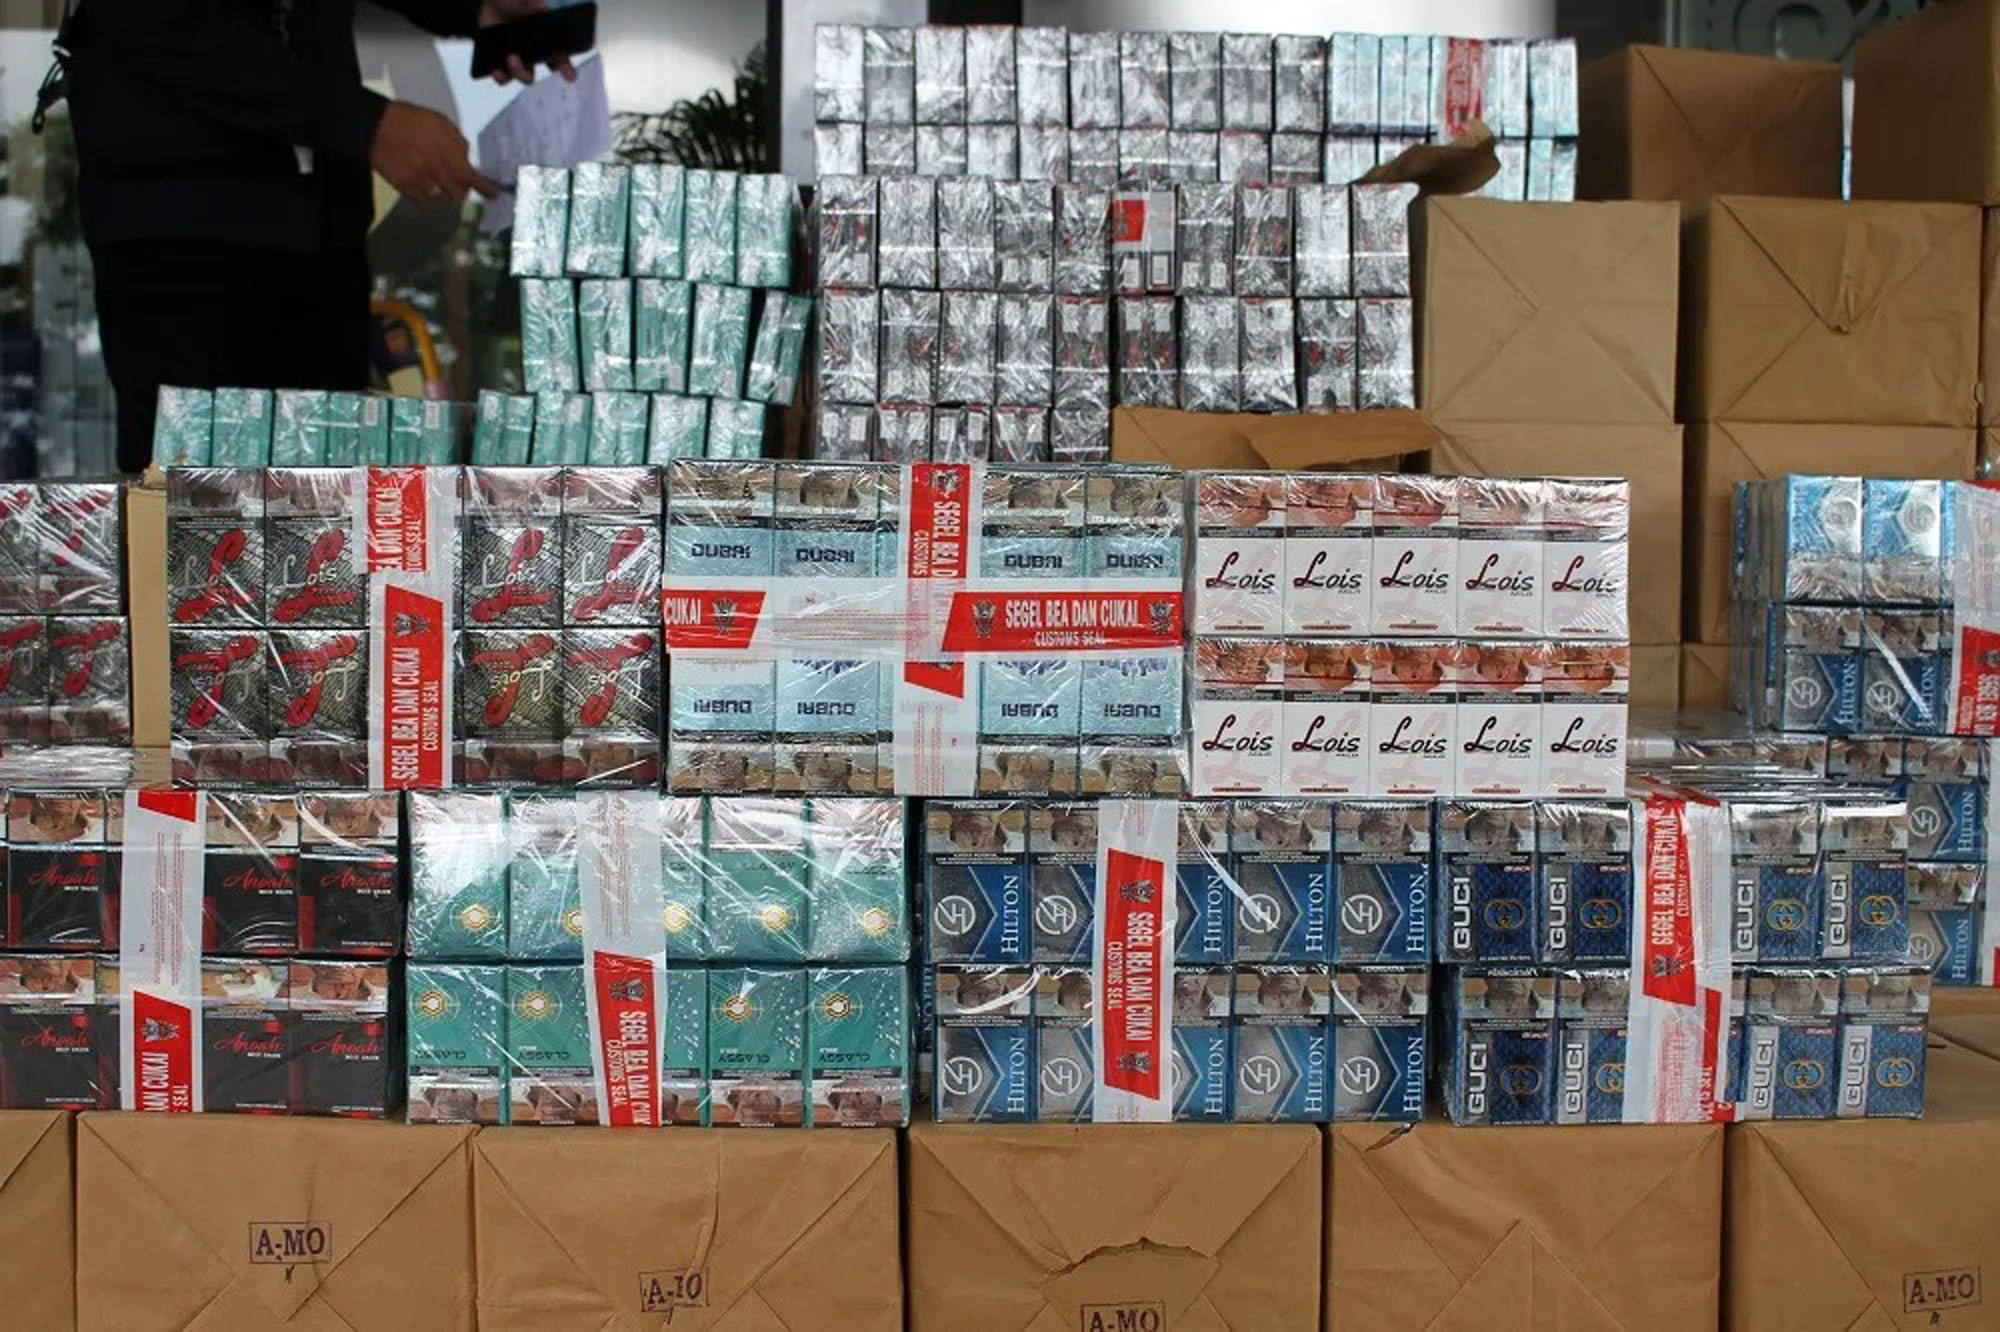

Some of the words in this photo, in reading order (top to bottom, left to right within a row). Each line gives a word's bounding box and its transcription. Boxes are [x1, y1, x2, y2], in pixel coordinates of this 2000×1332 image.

[933, 501, 961, 539] SEGEL
[376, 528, 402, 554] DAN
[691, 543, 750, 559] DUBAI
[796, 548, 854, 563] DUBAI
[914, 530, 929, 575] CUSTOMS
[932, 542, 960, 566] BEA
[279, 554, 337, 589] Lois
[1004, 553, 1062, 569] DUBAI
[1206, 551, 1275, 590] Lois
[1293, 550, 1362, 589] Lois
[1380, 550, 1449, 589] Lois
[1465, 553, 1534, 592] Lois
[664, 597, 701, 625] CUKAI
[1005, 600, 1043, 628] SEGEL
[1047, 600, 1070, 628] BEA
[1072, 600, 1097, 627] DAN
[1101, 600, 1139, 627] CUKAI
[1035, 631, 1079, 647] CUSTOMS
[391, 647, 420, 686] CUKAI
[490, 660, 552, 700] Lois
[391, 688, 419, 714] DAN
[422, 680, 439, 704] SEAL
[694, 699, 752, 714] DUBAI
[798, 701, 855, 716] DUBAI
[1002, 703, 1059, 718] DUBAI
[1104, 703, 1161, 718] DUBAI
[1836, 661, 1857, 724] HILTON
[391, 717, 419, 741] BEA
[422, 707, 439, 752] CUSTOMS
[1202, 714, 1274, 752] Lois
[1291, 715, 1361, 753] Lois
[1379, 715, 1447, 753] Lois
[1463, 715, 1533, 754] Lois
[1550, 716, 1618, 753] Lois
[391, 743, 419, 781] SEGEL
[1957, 791, 1975, 852] HILTON
[1654, 853, 1676, 879] DAN
[1002, 874, 1019, 954] HILTON
[1204, 874, 1223, 953] HILTON
[1305, 873, 1323, 952] HILTON
[1406, 875, 1425, 953] HILTON
[1453, 877, 1471, 950] GUCI
[1550, 877, 1567, 950] GUCI
[1653, 884, 1674, 907] BEA
[1830, 873, 1847, 945] GUCI
[1127, 911, 1155, 948] SEGEL
[1652, 910, 1674, 945] SEGEL
[1737, 879, 1754, 951] GUCI
[1107, 941, 1123, 984] CUSTOMS
[1126, 951, 1153, 974] BEA
[1952, 919, 1969, 979] HILTON
[1107, 987, 1123, 1010] SEAL
[1126, 976, 1153, 1002] DAN
[620, 1011, 648, 1045] SEGEL
[1126, 1005, 1153, 1041] CUKAI
[142, 1052, 169, 1089] CUKAI
[518, 1051, 571, 1060] CLASSY
[608, 1040, 626, 1083] CUSTOMS
[623, 1050, 648, 1072] BEA
[717, 1053, 770, 1063] CLASSY
[819, 1052, 871, 1063] CLASSY
[1304, 1035, 1324, 1113] HILTON
[1403, 1035, 1423, 1113] HILTON
[1753, 1039, 1774, 1109] GUCI
[1846, 1037, 1868, 1105] GUCI
[627, 1075, 649, 1099] DAN
[1007, 1036, 1026, 1113] HILTON
[1204, 1037, 1224, 1115] HILTON
[1469, 1043, 1487, 1115] GUCI
[1565, 1043, 1583, 1113] GUCI
[172, 1085, 188, 1107] SEAL
[611, 1087, 628, 1107] SEAL
[255, 1226, 326, 1257] A-MO
[1908, 1273, 1975, 1305] A-MO
